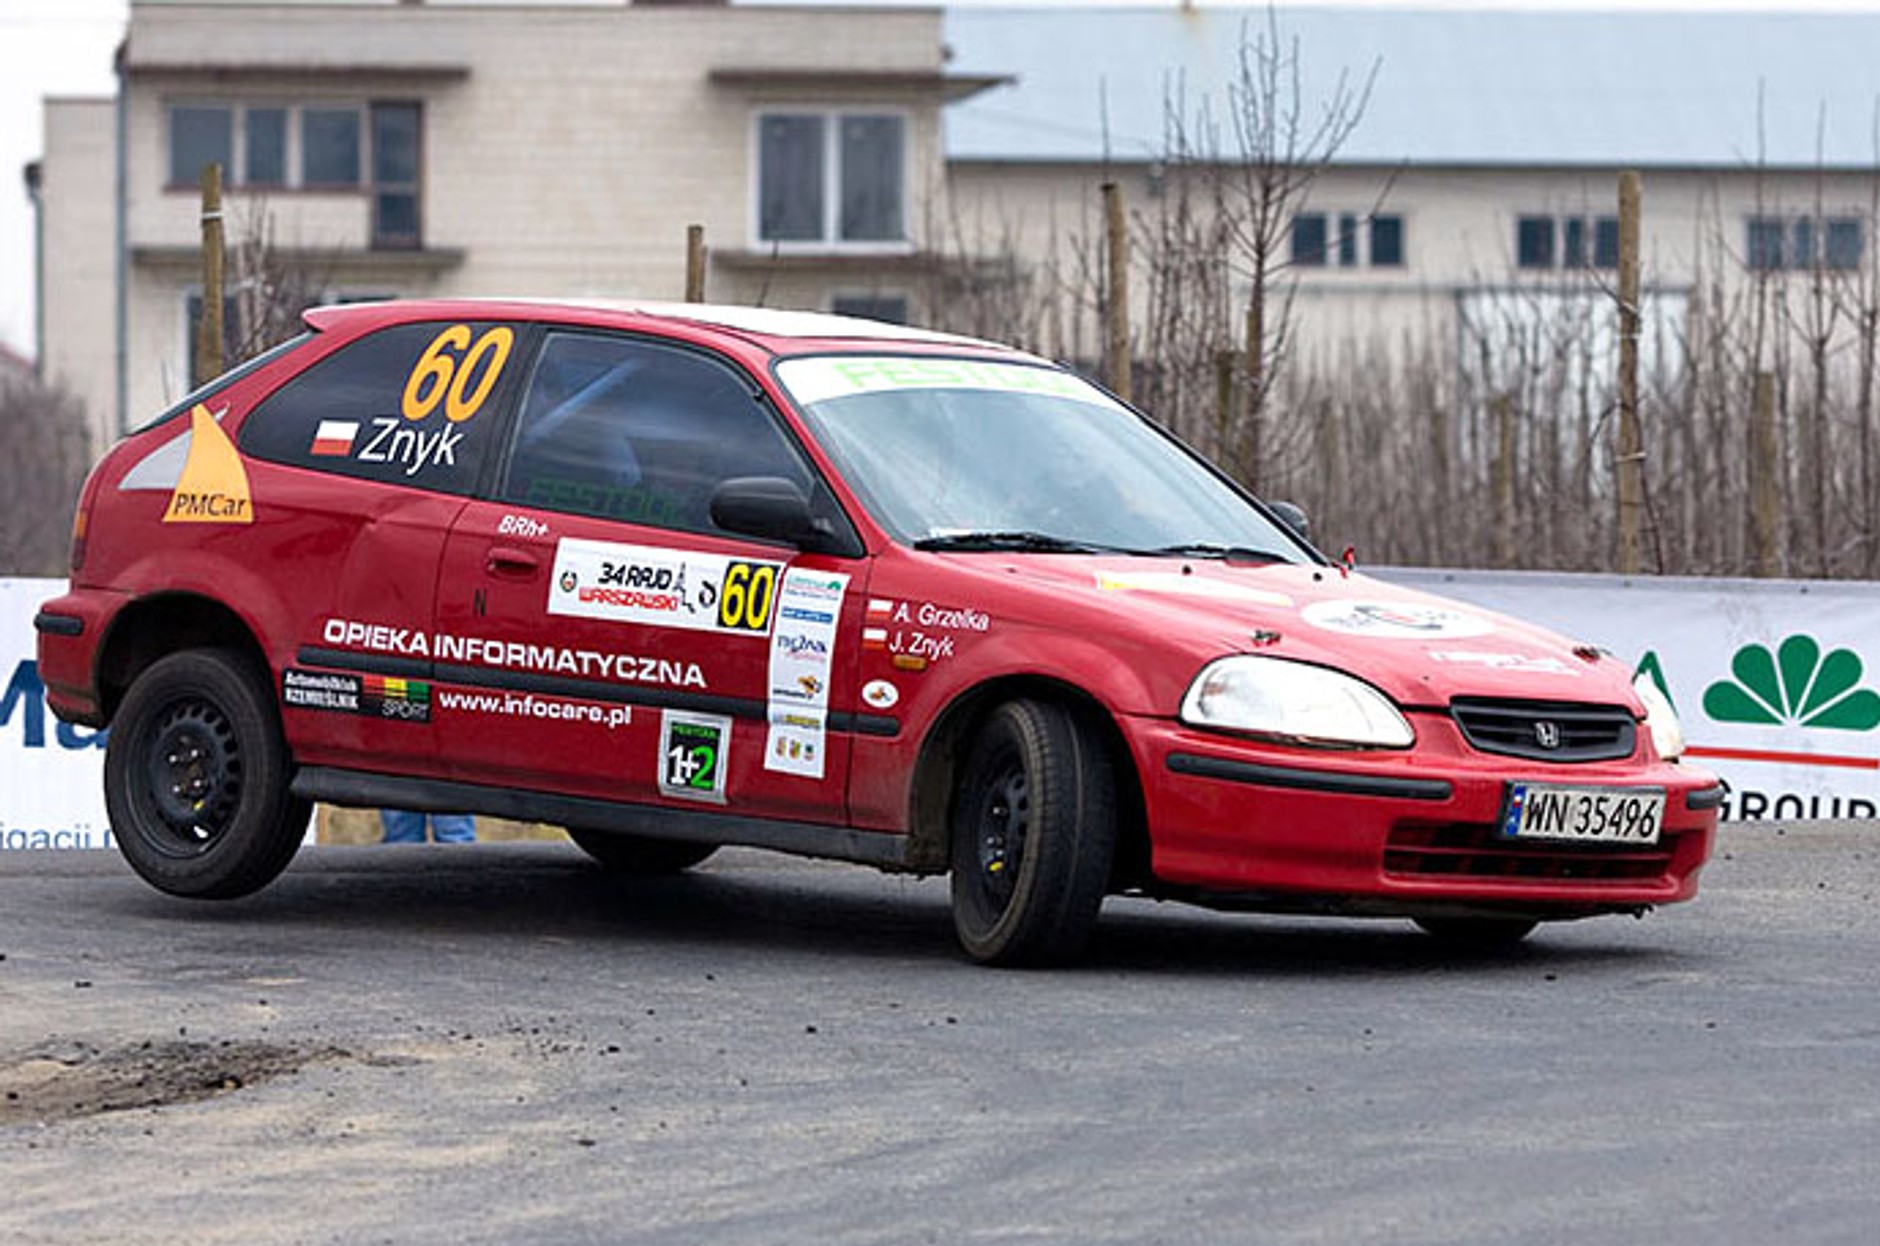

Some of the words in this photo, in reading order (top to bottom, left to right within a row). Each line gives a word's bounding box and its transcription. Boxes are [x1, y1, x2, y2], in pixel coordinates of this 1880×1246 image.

[402, 324, 514, 422] 60
[359, 418, 464, 475] Znyk
[173, 493, 246, 517] PMCar
[720, 563, 774, 630] 60
[918, 603, 989, 632] Grzelka
[323, 618, 430, 656] OPIEKA
[433, 634, 707, 688] INFORMATYCZNA
[888, 633, 905, 653] J.
[909, 633, 954, 662] Znyk
[381, 699, 430, 720] SPORT
[438, 690, 632, 727] www.infocare.pl
[669, 744, 716, 788] 1+2
[1526, 786, 1568, 834] WN
[1574, 796, 1658, 840] 35496
